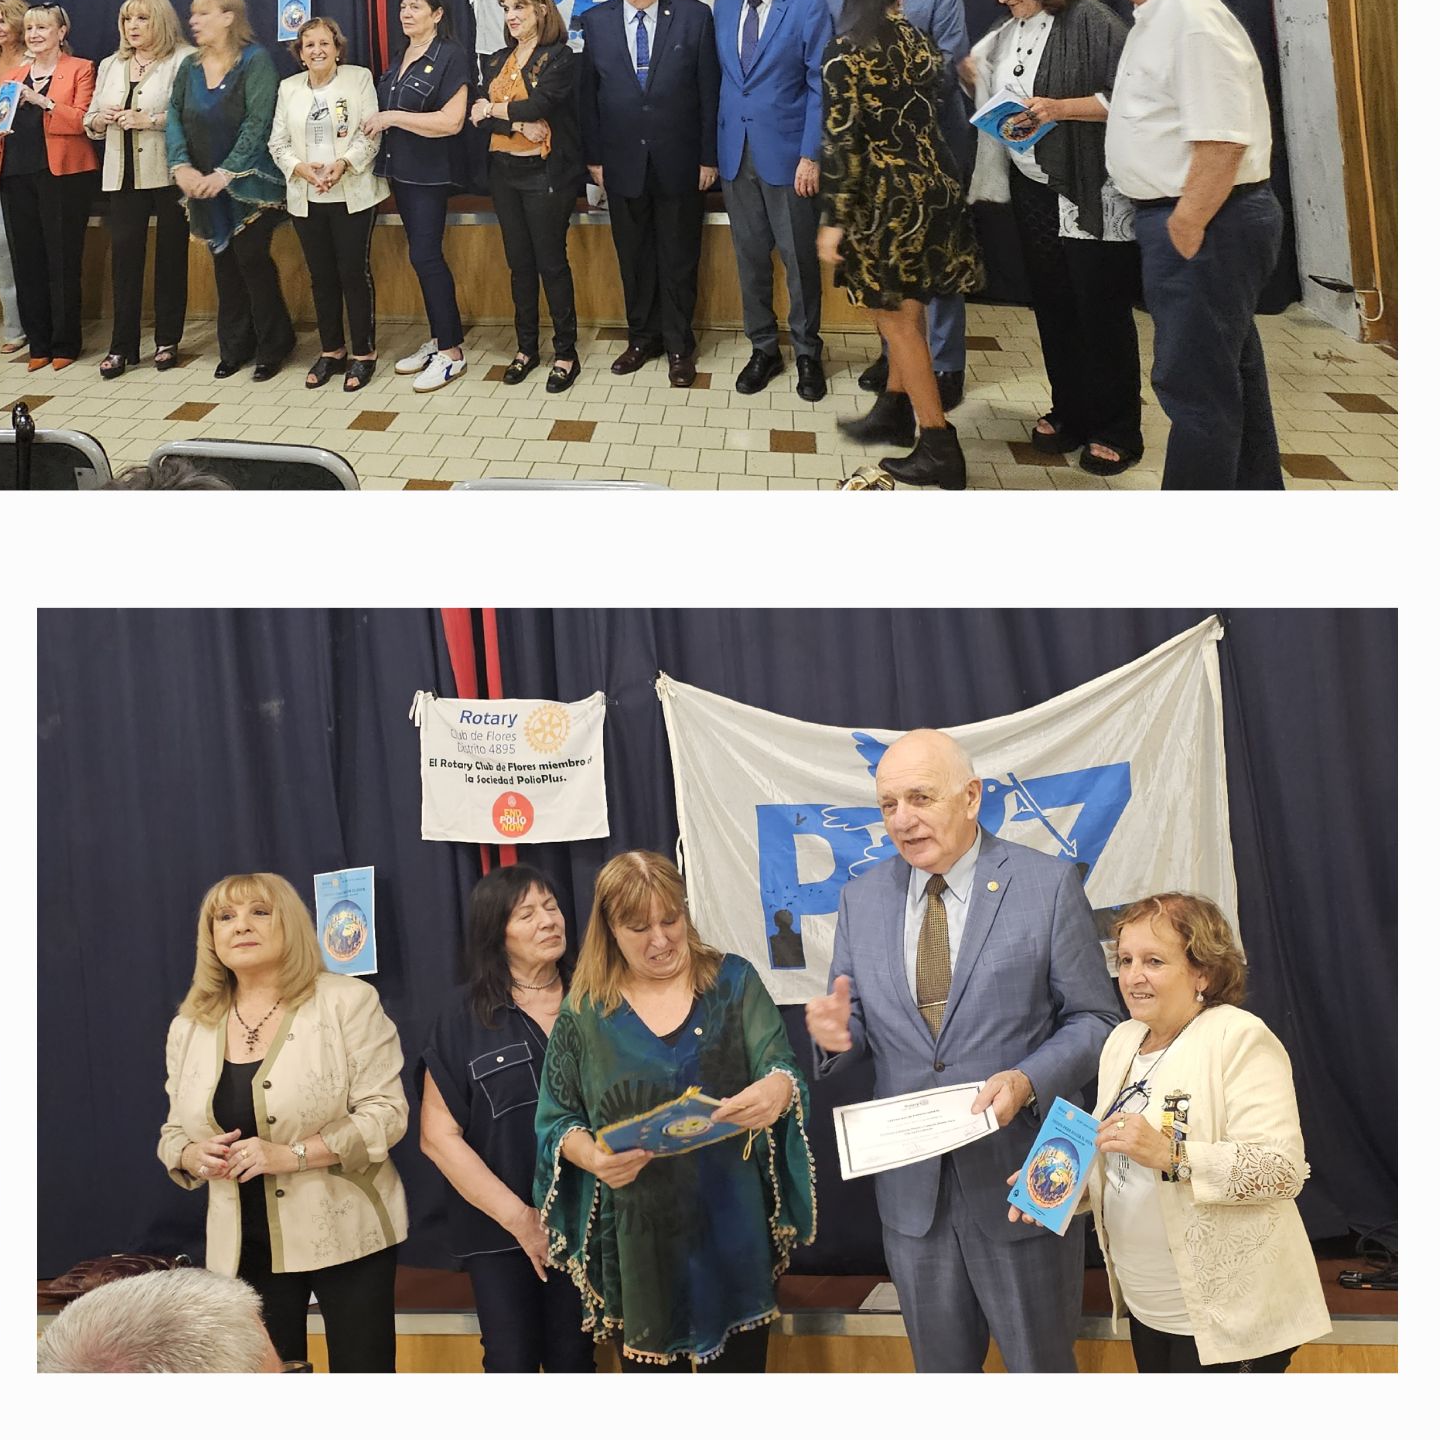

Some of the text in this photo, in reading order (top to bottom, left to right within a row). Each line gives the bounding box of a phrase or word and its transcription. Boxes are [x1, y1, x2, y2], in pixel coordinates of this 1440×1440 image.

[460, 710, 518, 728] Rotary
[471, 729, 483, 741] de
[486, 731, 517, 742] Flores
[457, 744, 516, 755] Distrito 4895
[429, 758, 437, 767] El
[441, 759, 472, 771] Rotary
[475, 762, 494, 771] Club
[496, 762, 506, 772] de
[508, 763, 536, 772] Flores
[539, 759, 586, 771] miembro
[465, 774, 567, 785] la Sociedad PolioPlus.
[504, 809, 522, 817] END
[500, 816, 527, 825] POLIO
[502, 823, 523, 832] NOW
